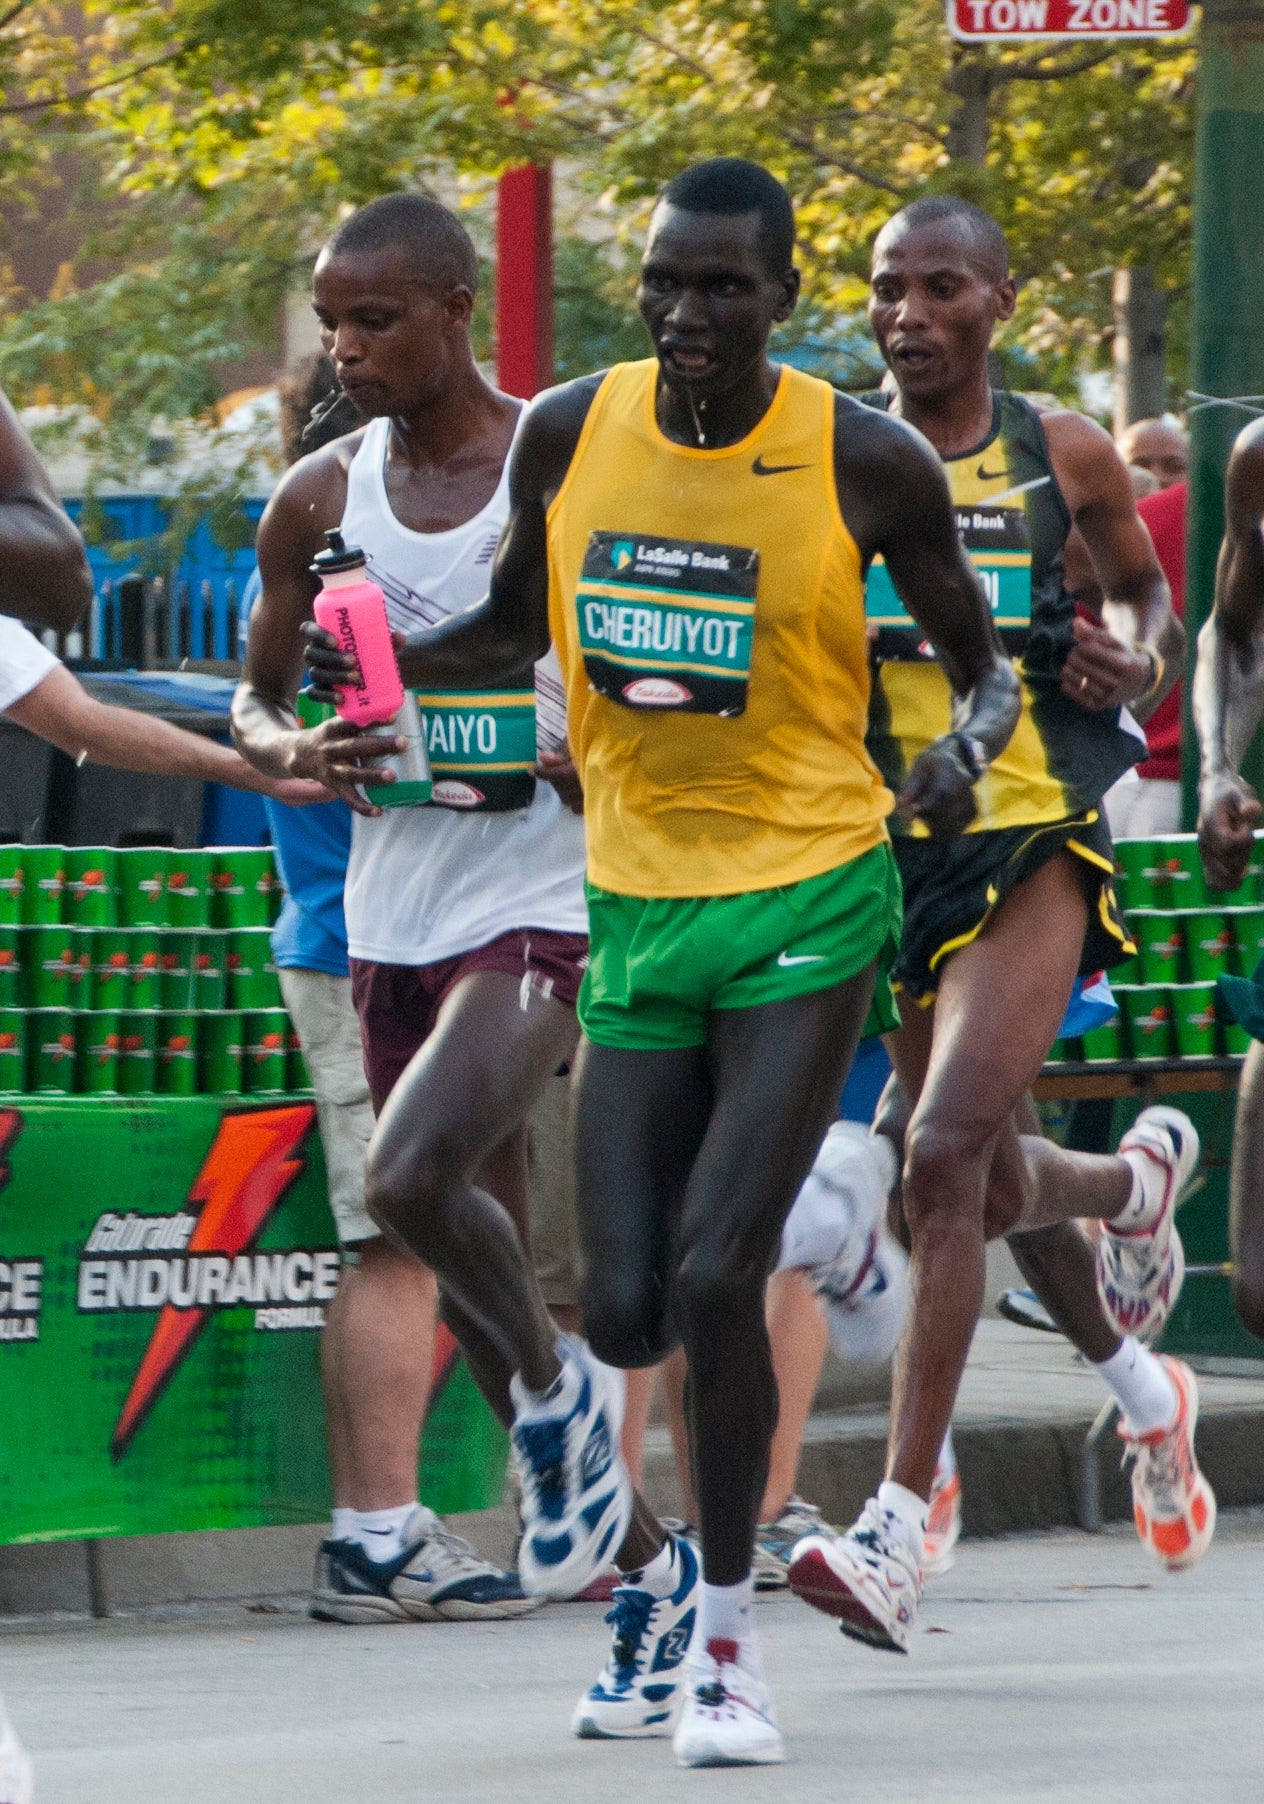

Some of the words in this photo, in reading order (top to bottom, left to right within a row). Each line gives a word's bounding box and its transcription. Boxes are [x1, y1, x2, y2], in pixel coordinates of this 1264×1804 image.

[966, 0, 1048, 30] TOW
[1067, 0, 1171, 29] ZONE
[973, 512, 1005, 529] Bank
[636, 544, 691, 567] LaSalle
[691, 551, 730, 571] Bank
[584, 601, 745, 659] CHERUIYOT
[77, 1251, 341, 1309] ENDURANCE
[254, 1306, 326, 1330] FORMUL
